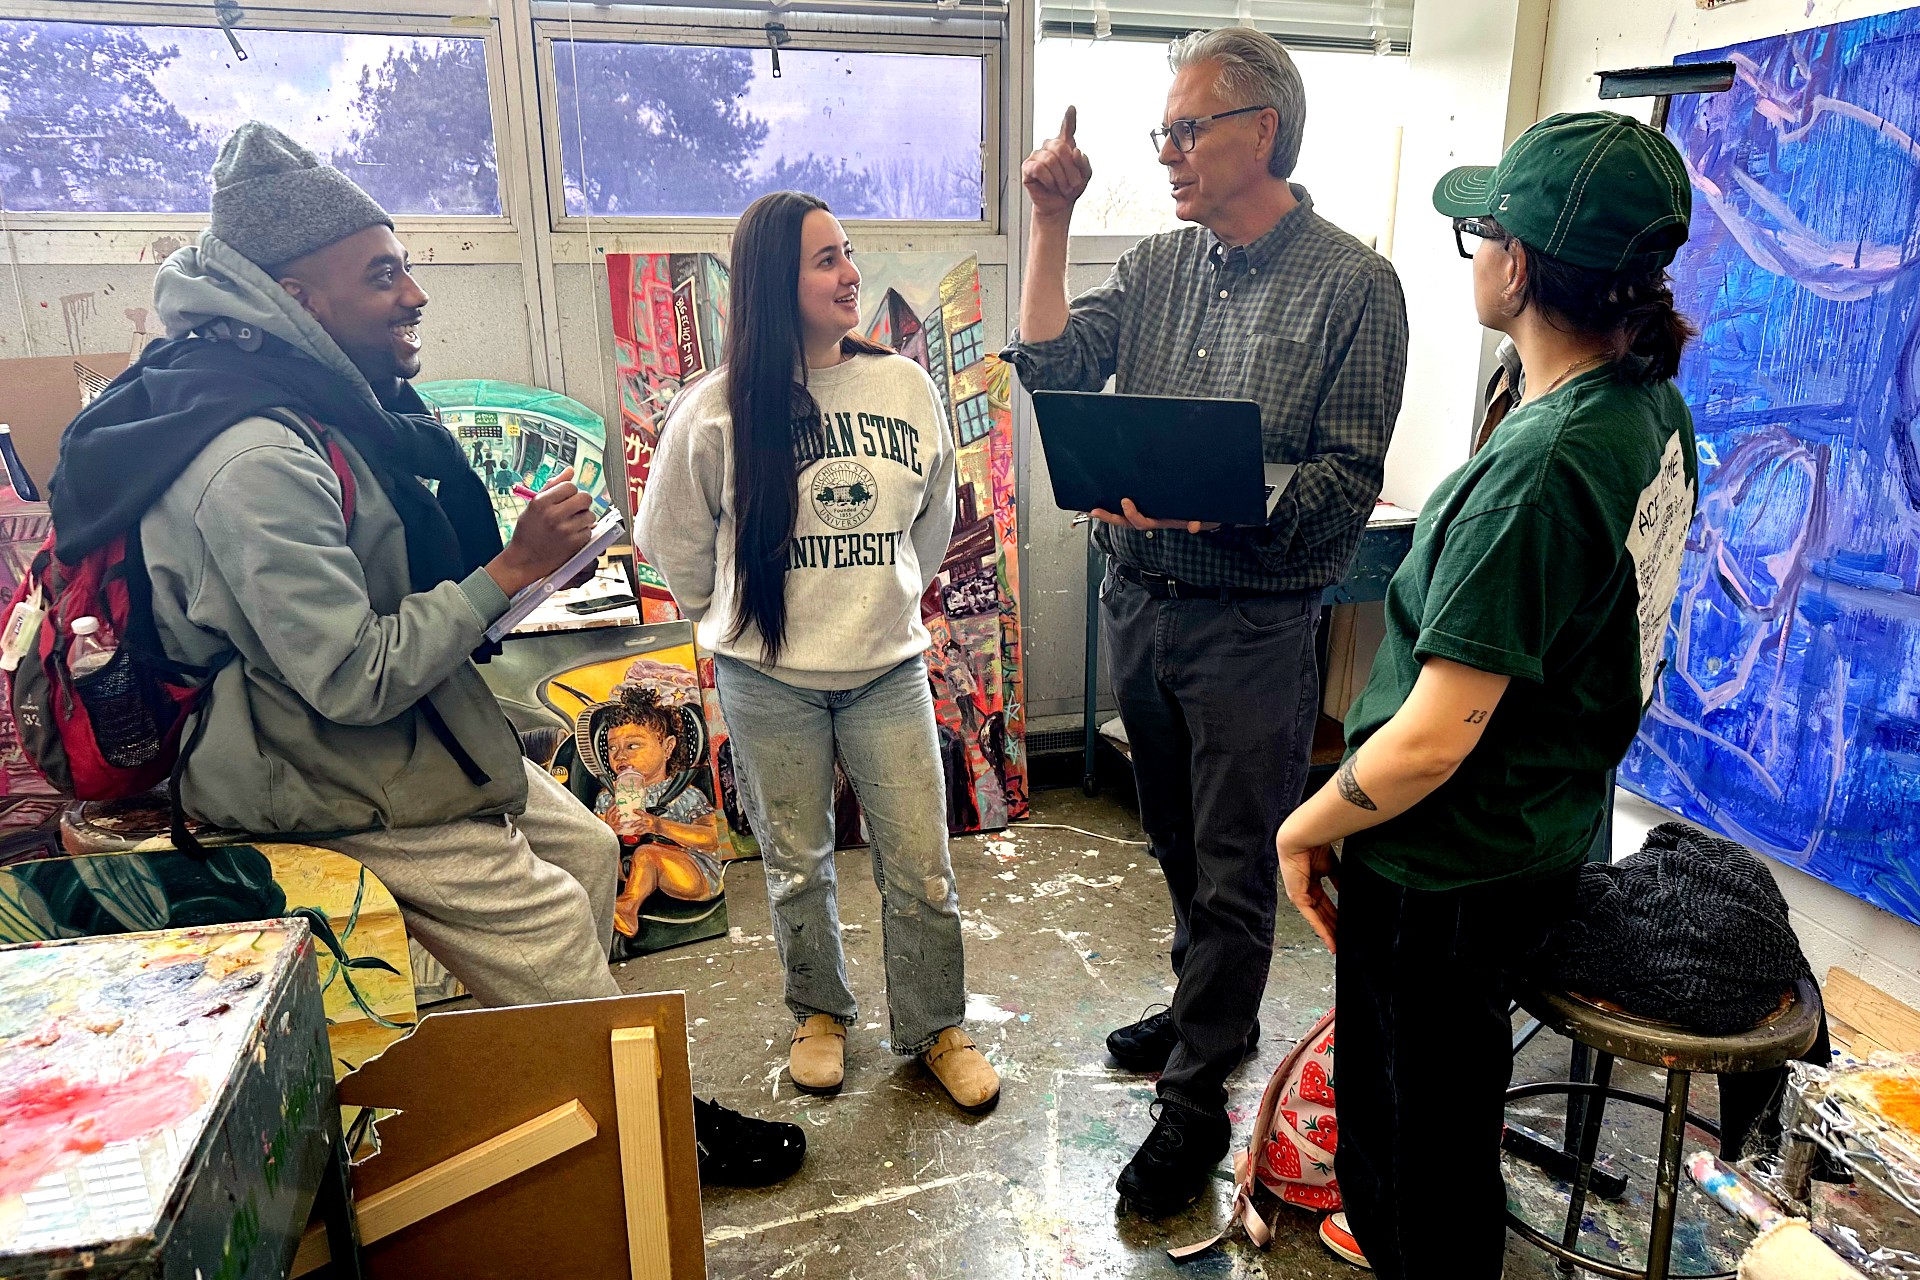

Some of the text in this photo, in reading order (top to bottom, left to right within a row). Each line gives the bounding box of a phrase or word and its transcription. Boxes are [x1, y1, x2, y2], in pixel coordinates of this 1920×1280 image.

[675, 296, 691, 341] BIG ECHO
[857, 412, 923, 477] STATE
[814, 463, 875, 491] MICHIGAN STATE
[819, 507, 871, 528] UNIVERSITY
[22, 712, 42, 728] 32
[1463, 709, 1488, 725] 13
